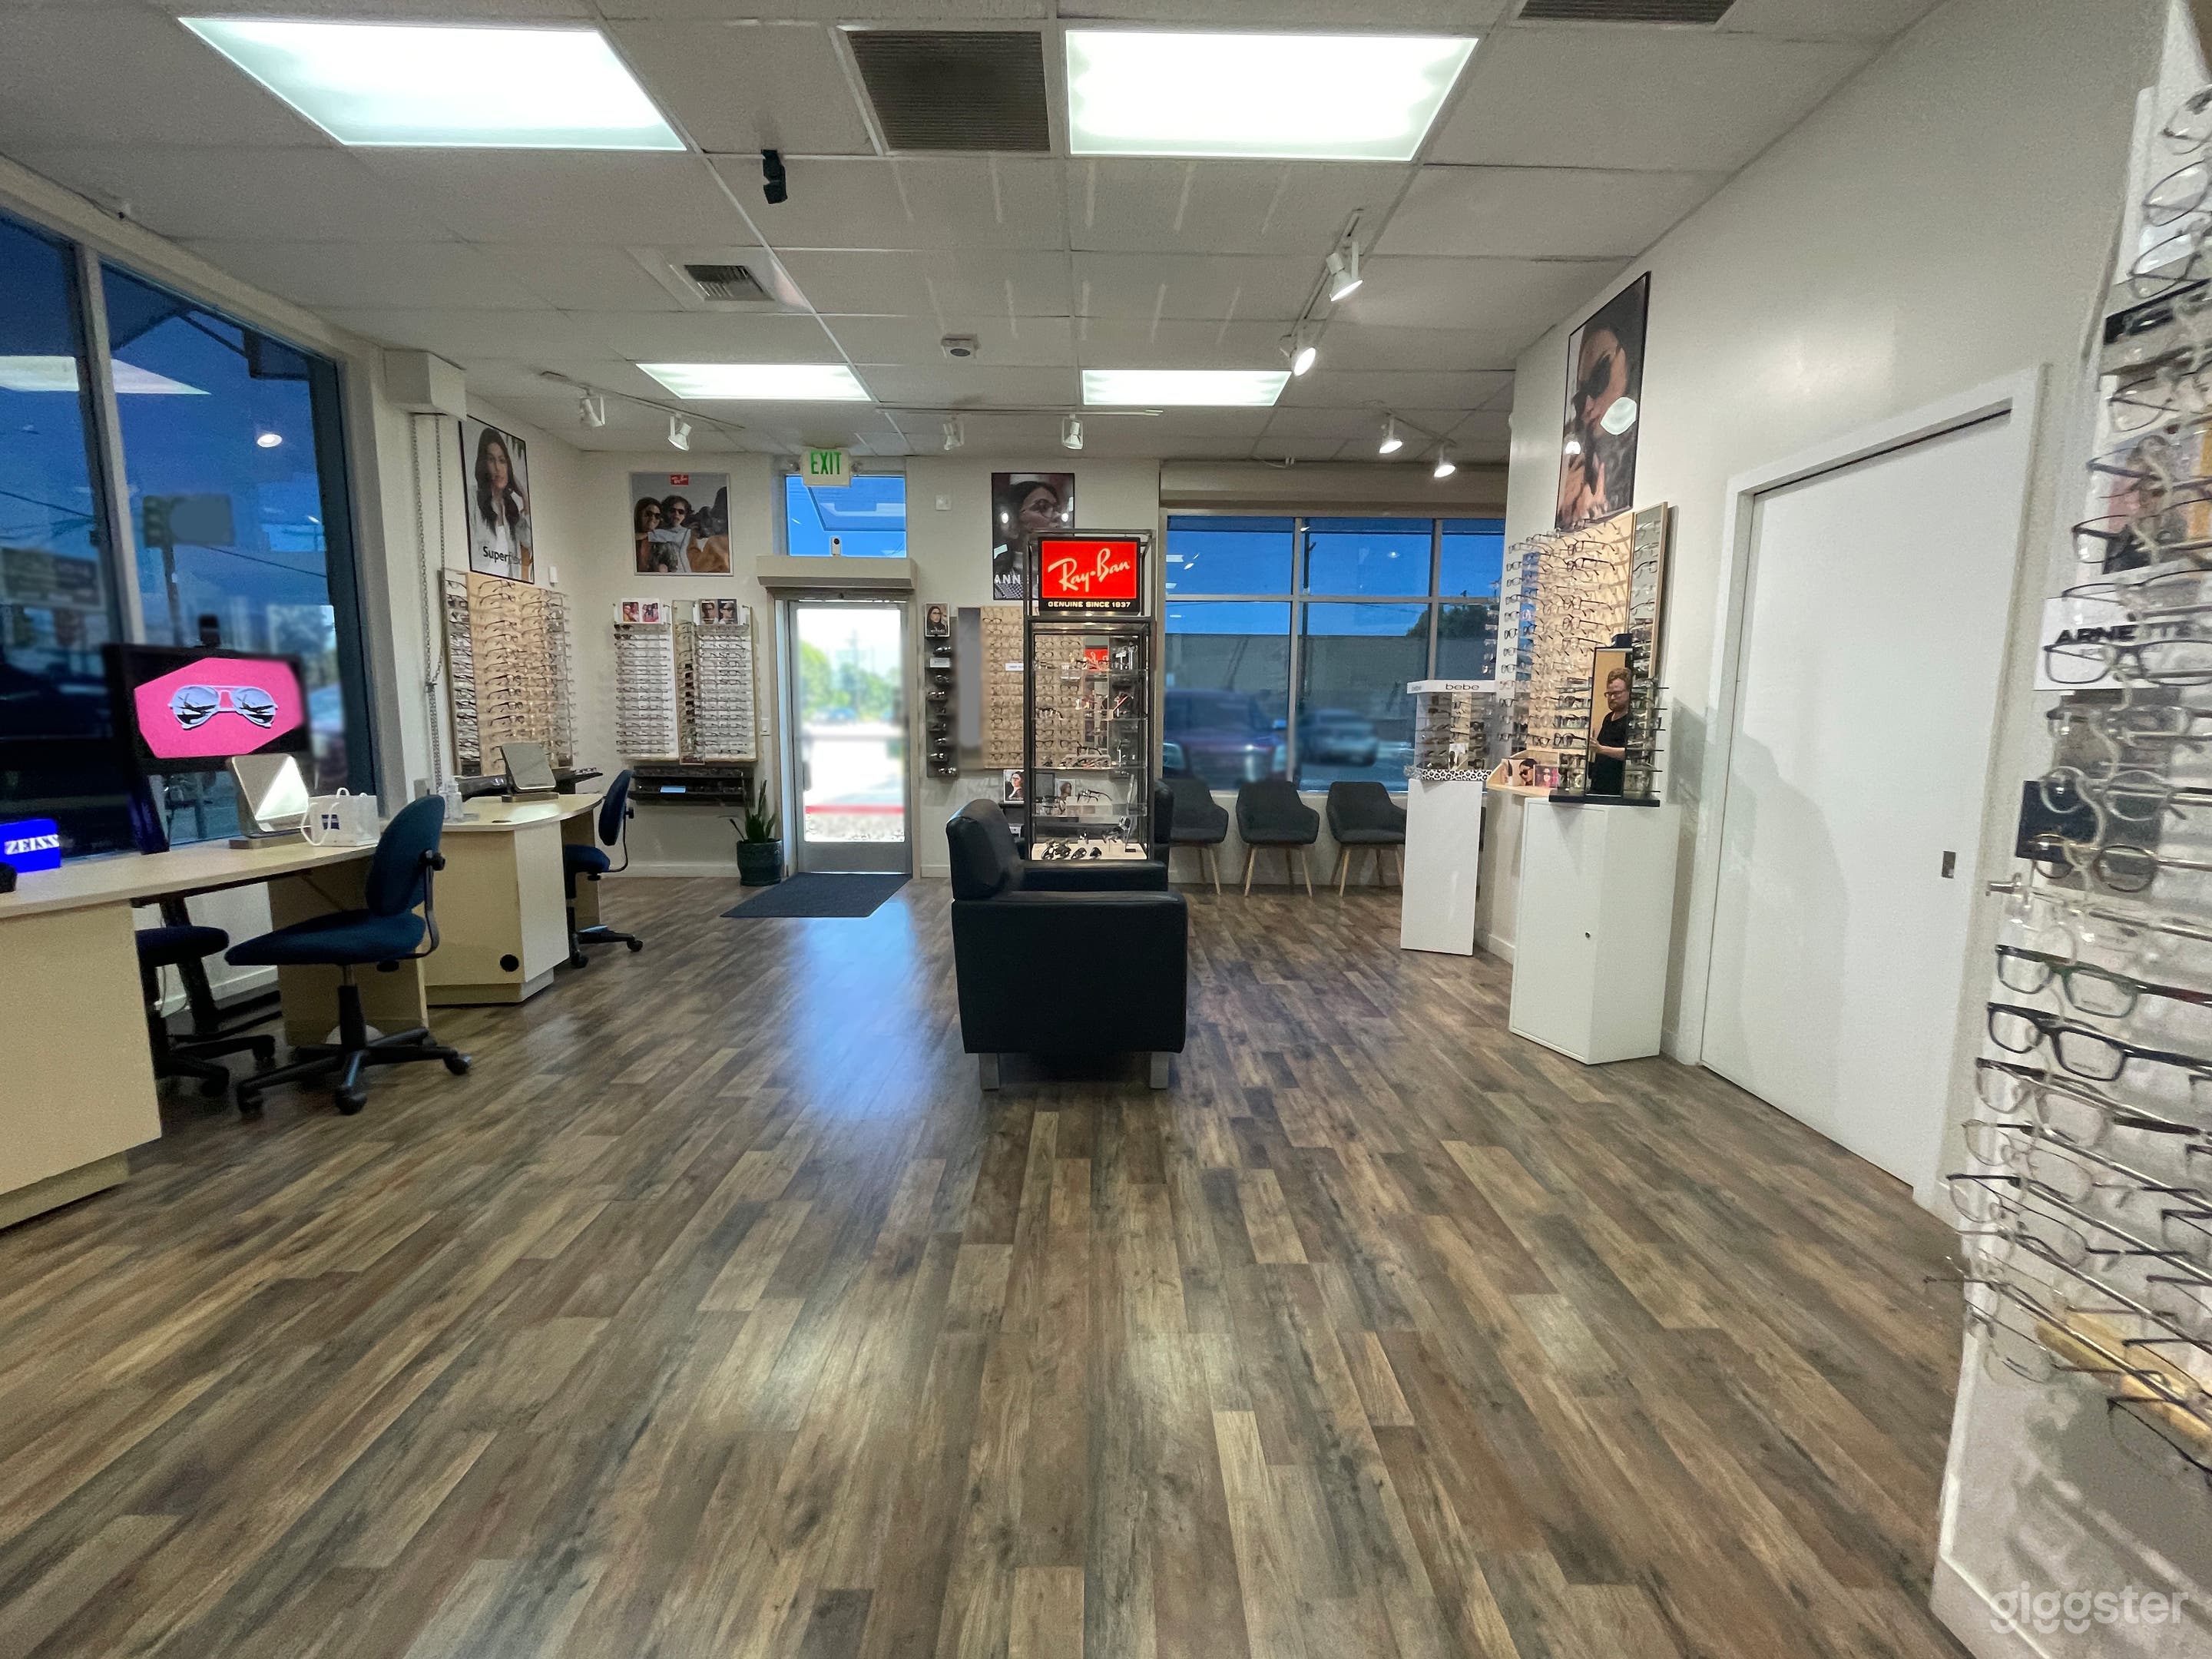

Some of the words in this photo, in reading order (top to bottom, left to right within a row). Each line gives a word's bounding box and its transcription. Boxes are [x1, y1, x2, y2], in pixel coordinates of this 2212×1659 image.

[810, 451, 842, 475] EXIT
[994, 574, 1029, 584] ANN
[1048, 548, 1131, 592] Ray-Ban
[4, 833, 60, 855] ZEISS
